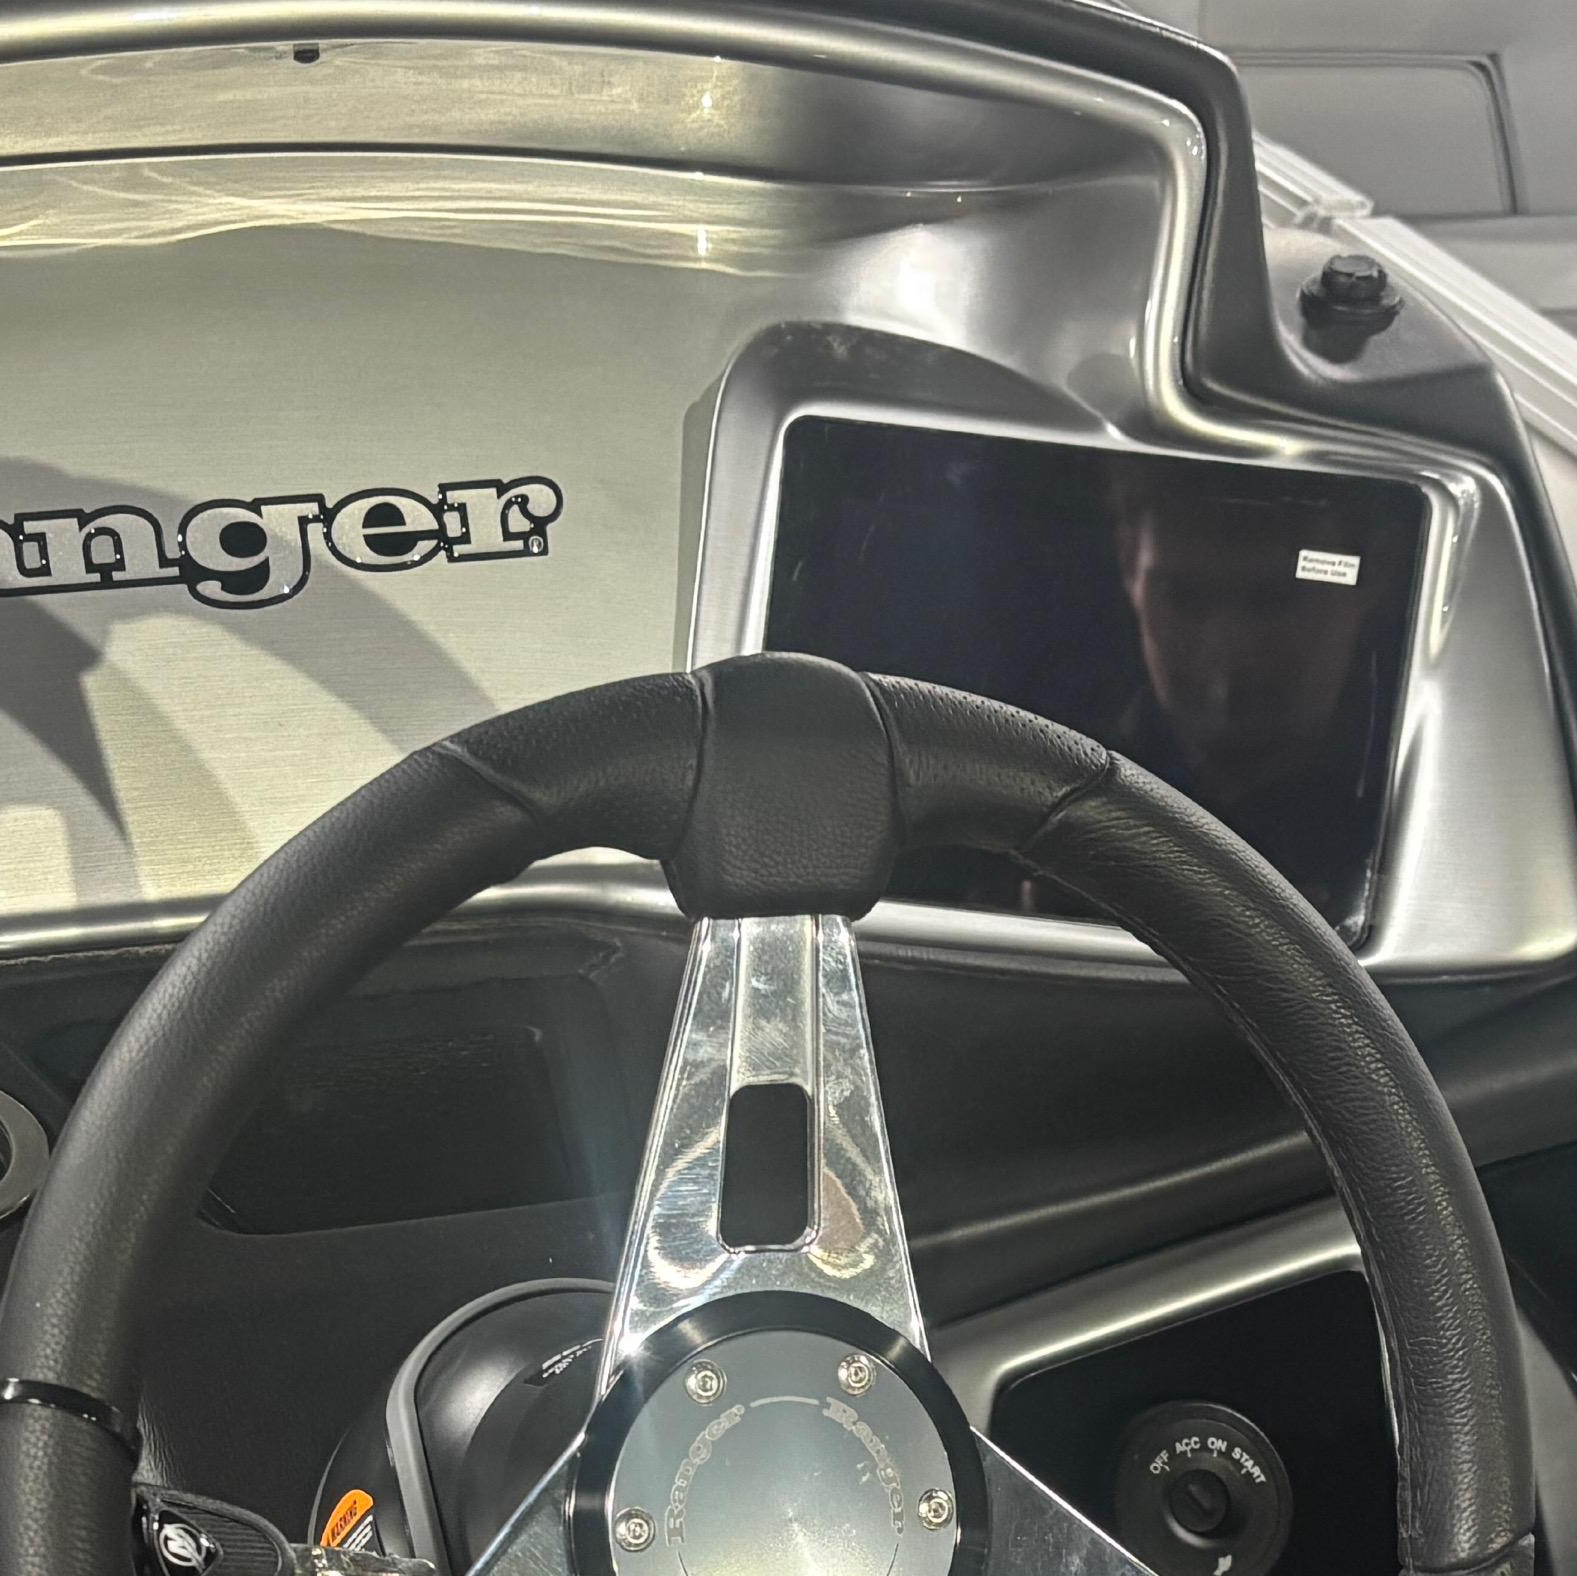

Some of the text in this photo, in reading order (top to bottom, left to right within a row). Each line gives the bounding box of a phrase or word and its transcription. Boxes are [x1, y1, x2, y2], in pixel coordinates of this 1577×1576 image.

[664, 1403, 746, 1548] Ranger
[822, 1397, 906, 1535] Ranger
[1149, 1437, 1268, 1485] OFF ACC ON START
